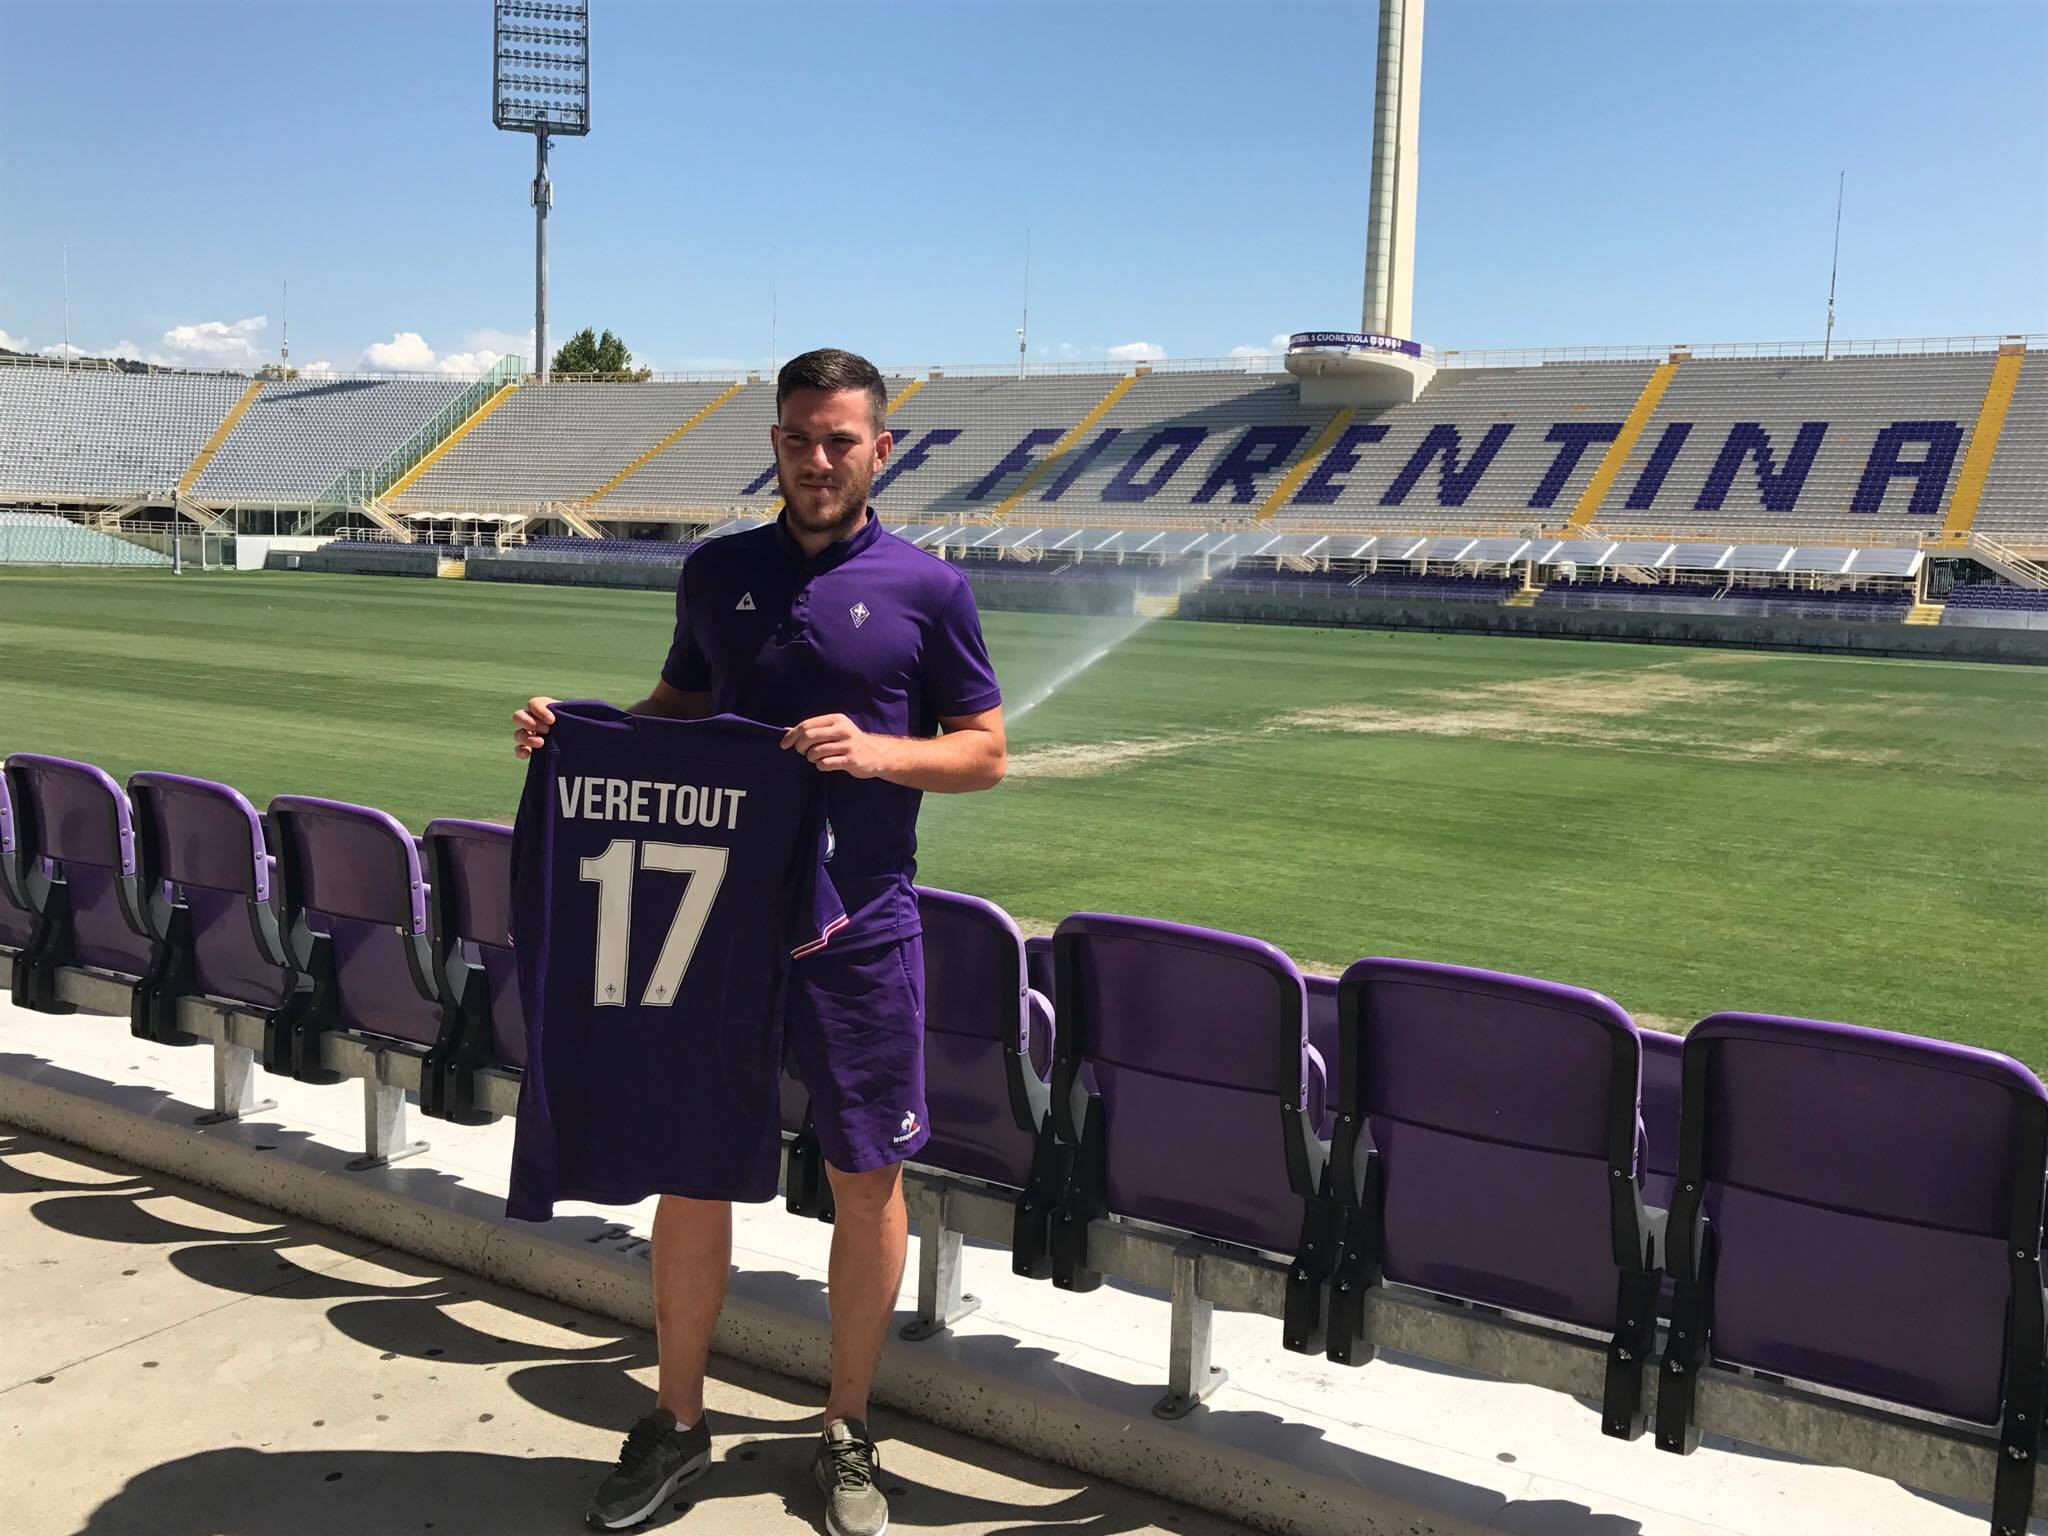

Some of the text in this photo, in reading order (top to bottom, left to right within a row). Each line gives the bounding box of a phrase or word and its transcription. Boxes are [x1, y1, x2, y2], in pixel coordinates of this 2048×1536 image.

[1317, 334, 1345, 342] CUORE
[1346, 335, 1368, 343] VIOLA
[967, 421, 1965, 515] FIORENTINA
[557, 776, 747, 830] VERETOUT
[579, 838, 730, 1008] 17
